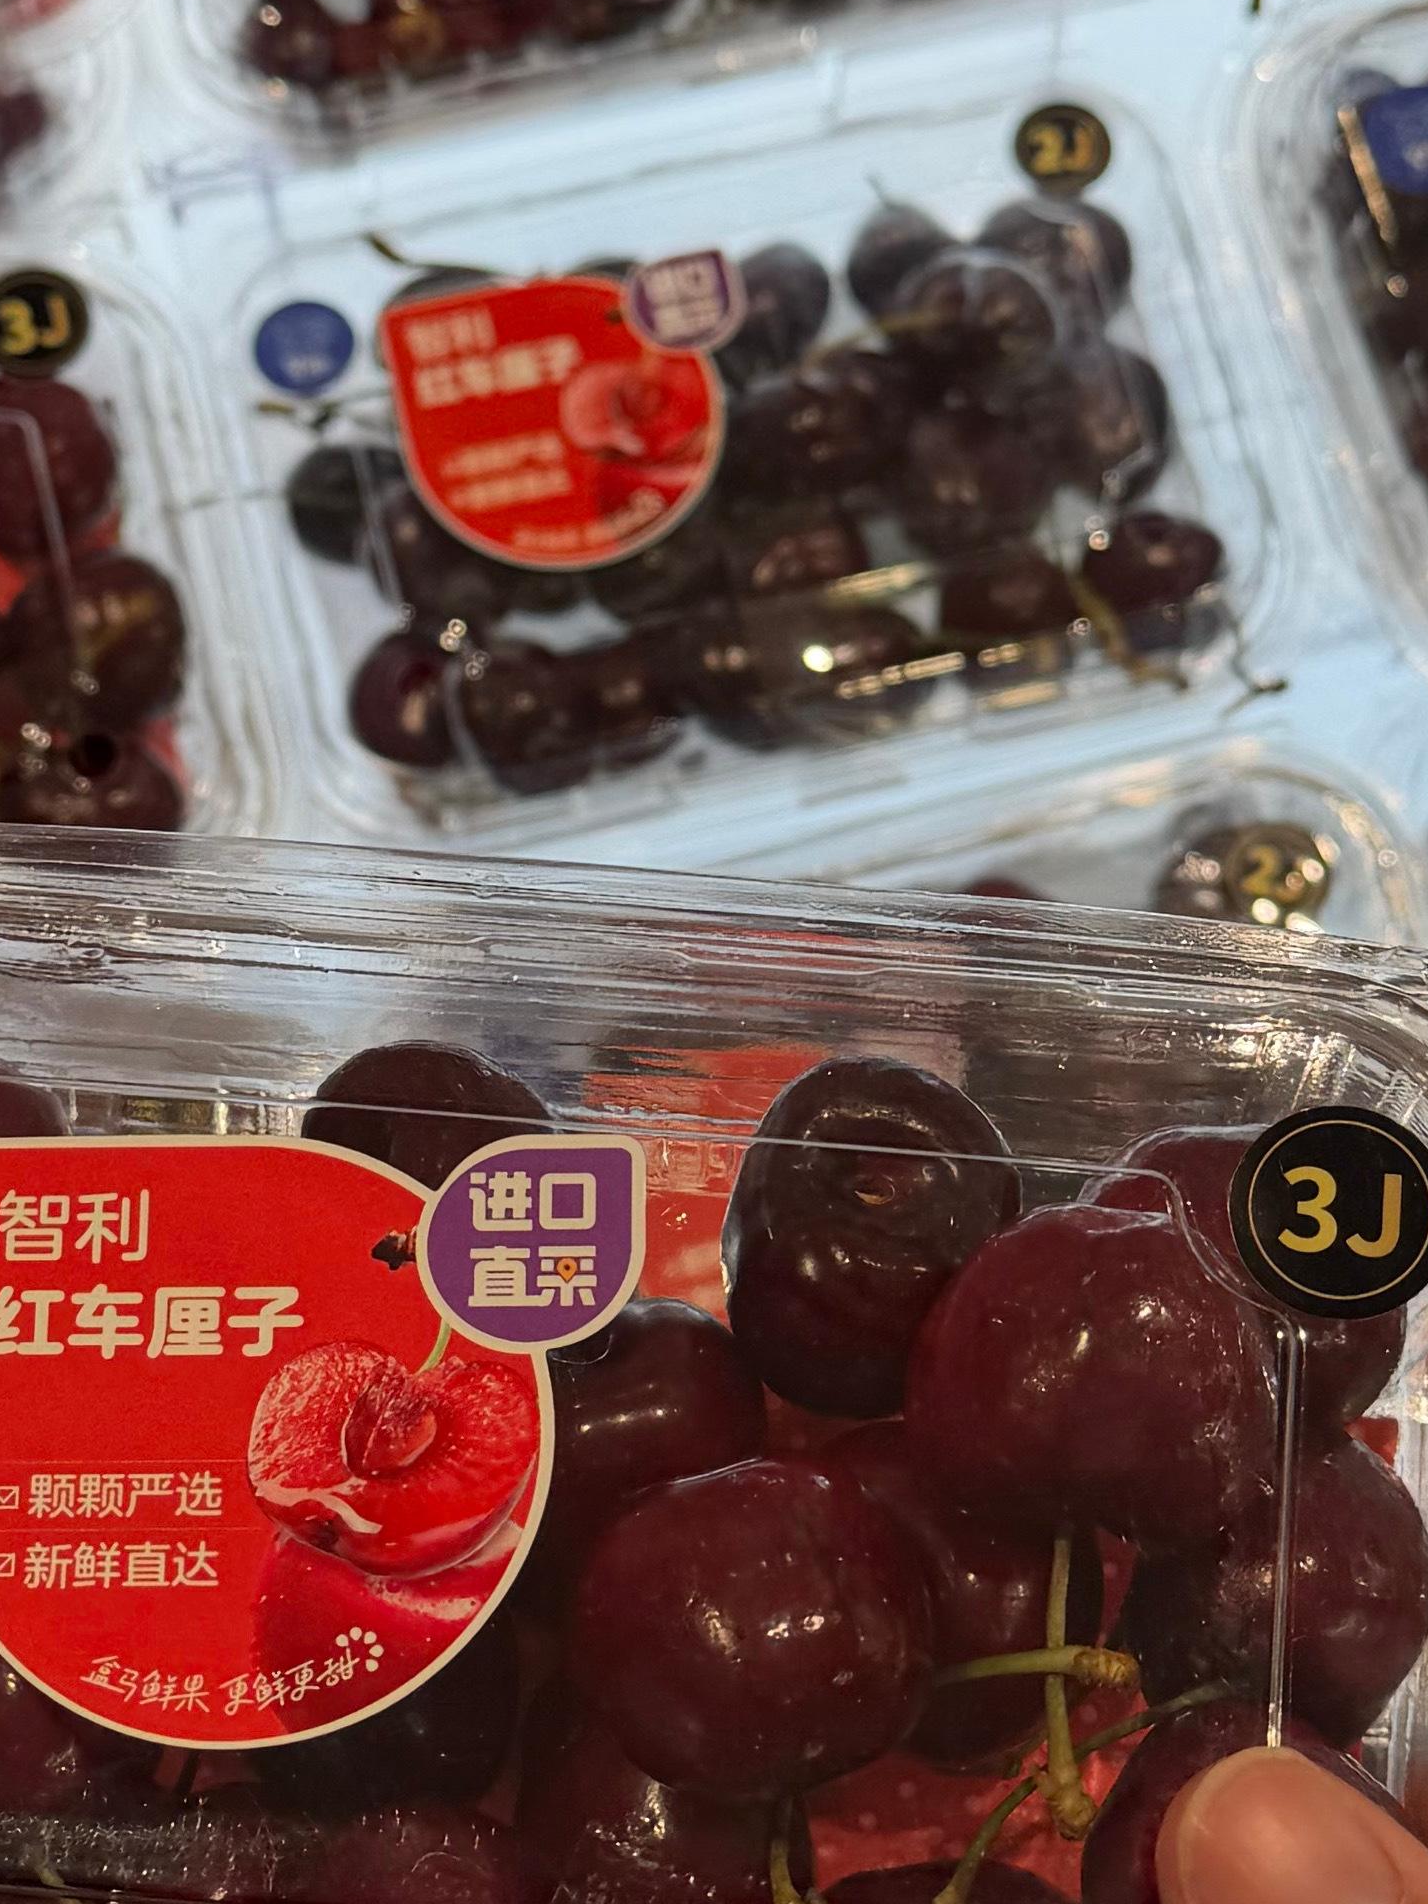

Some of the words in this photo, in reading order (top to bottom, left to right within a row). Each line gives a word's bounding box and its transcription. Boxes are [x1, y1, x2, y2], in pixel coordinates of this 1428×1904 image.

[468, 1170, 597, 1232] 进口
[1277, 1165, 1403, 1258] 3J
[468, 1246, 599, 1308] 直采
[27, 1471, 224, 1520] 颗颗严选
[22, 1540, 220, 1591] 新鲜直达
[79, 1654, 212, 1714] 盒马鲜果
[218, 1647, 362, 1717] 更鲜更甜
